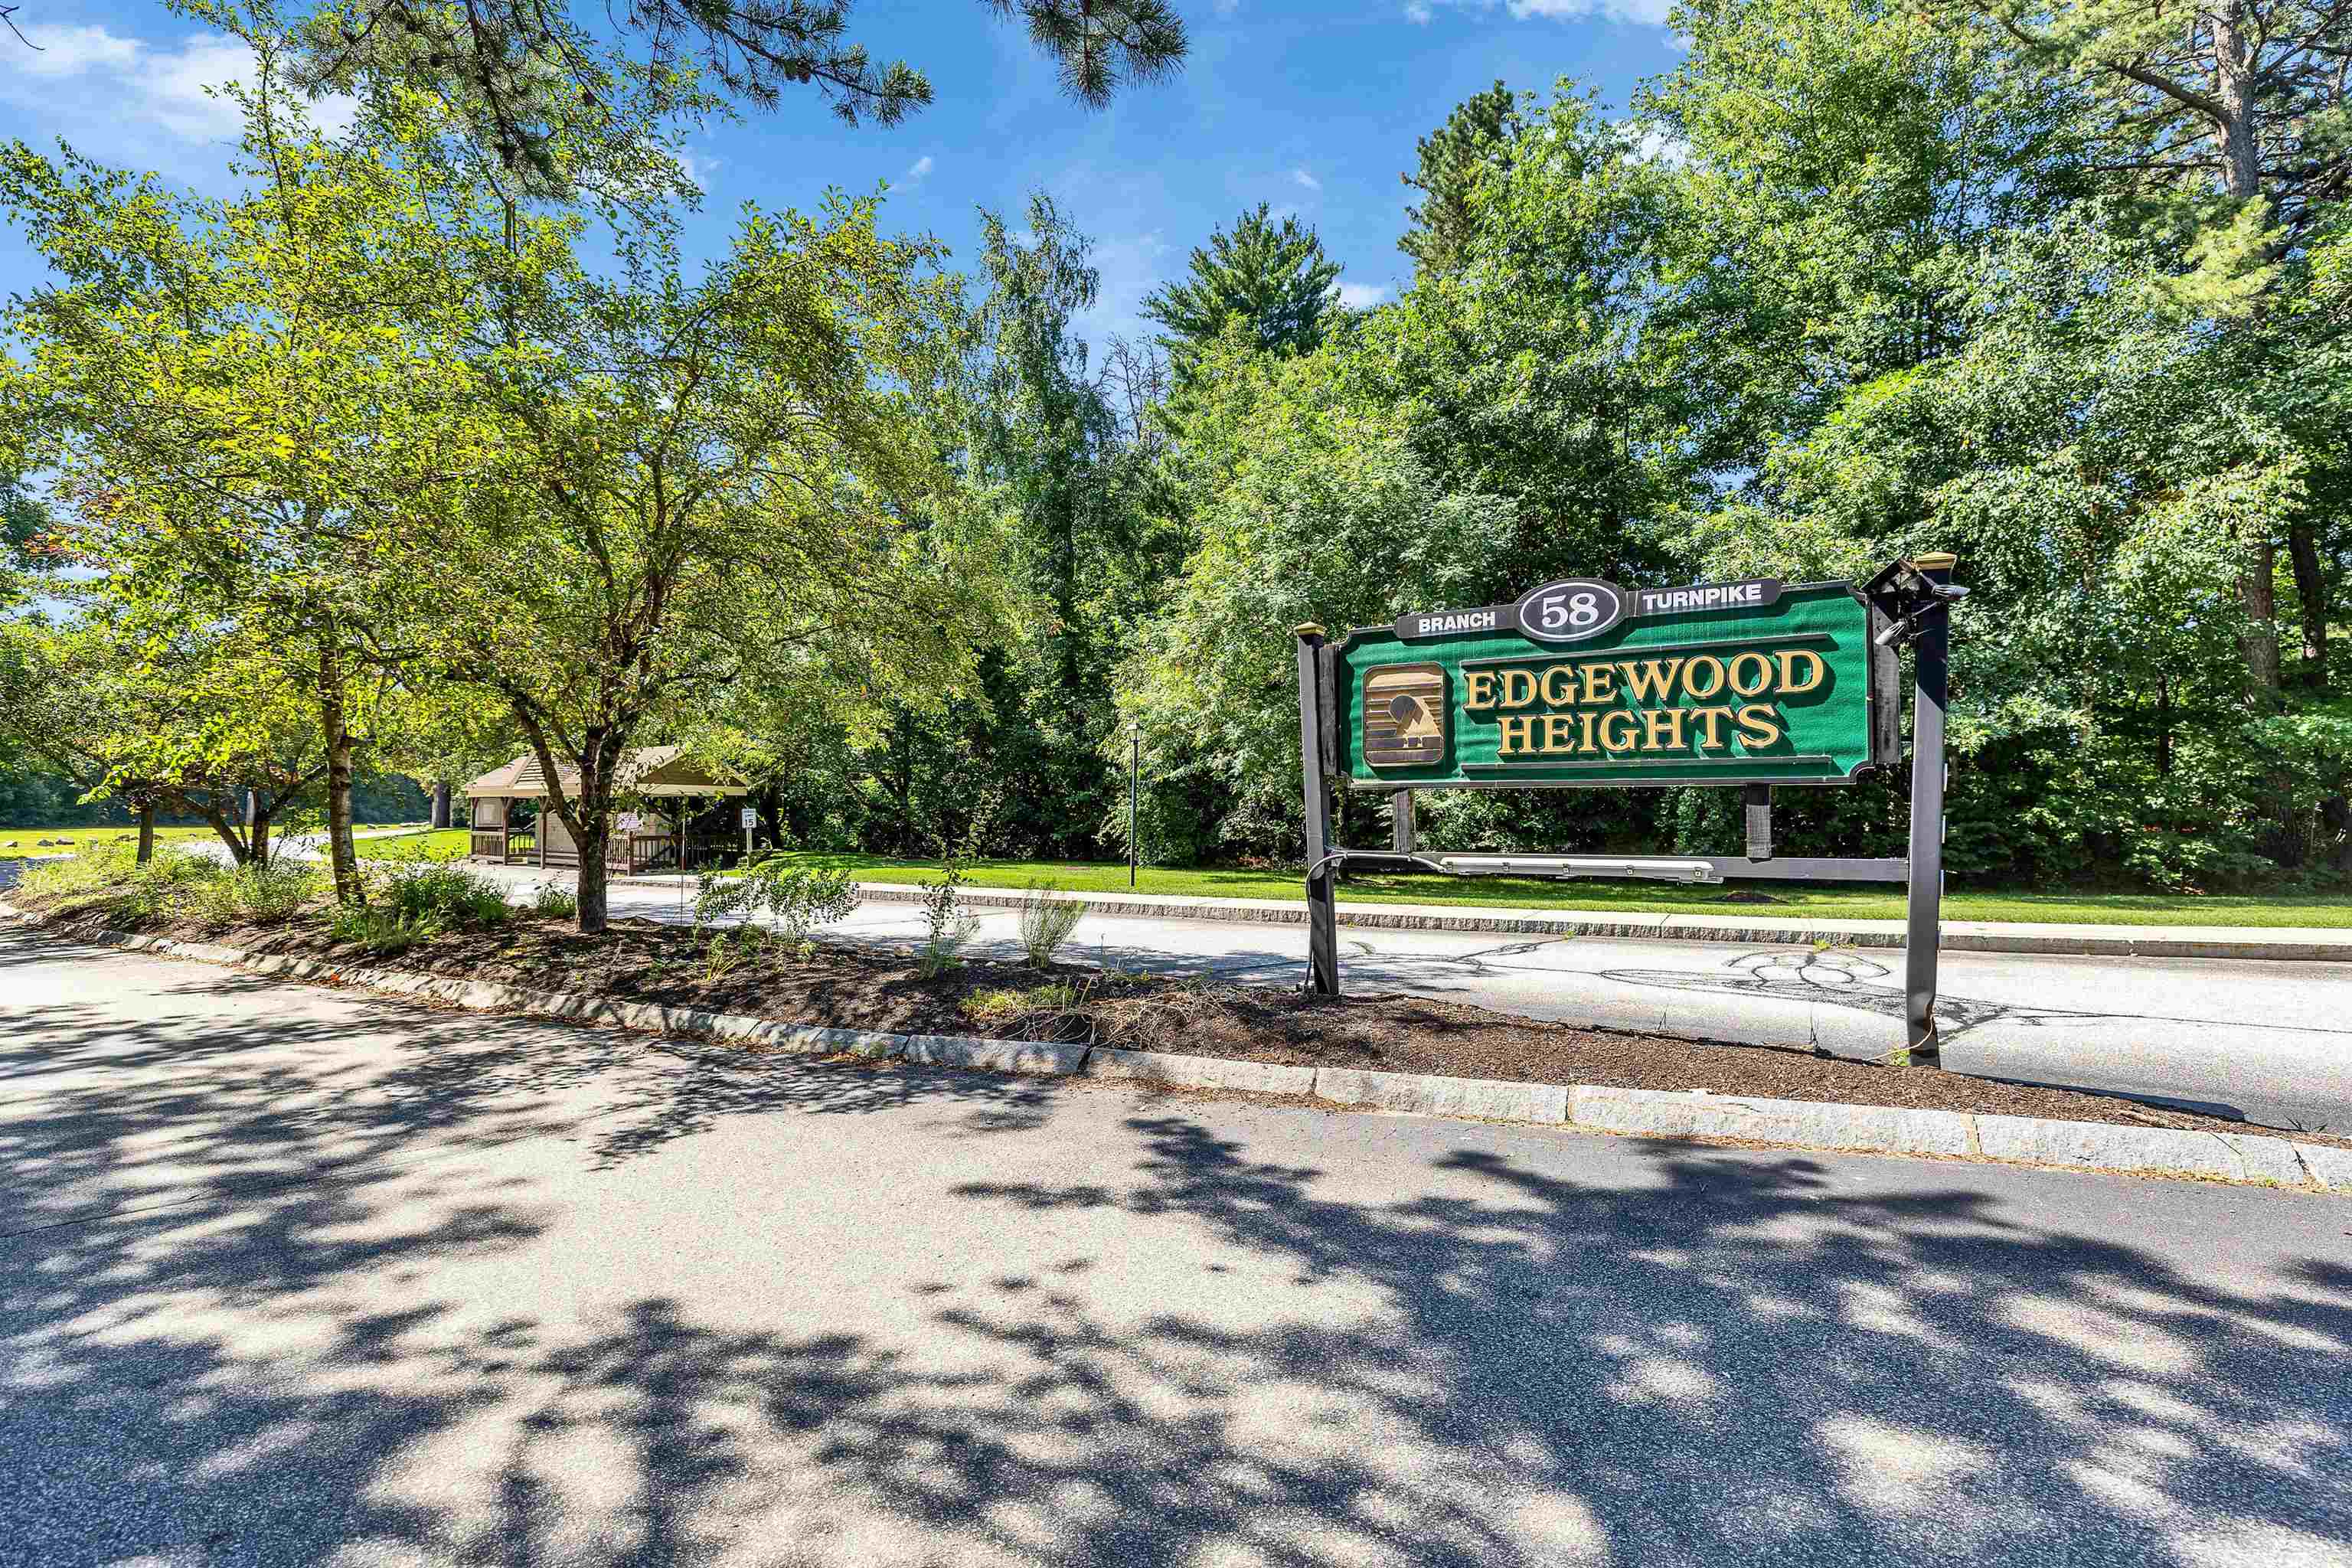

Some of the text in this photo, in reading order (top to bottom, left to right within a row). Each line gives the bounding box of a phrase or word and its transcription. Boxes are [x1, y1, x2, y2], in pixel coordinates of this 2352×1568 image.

[1419, 583, 1762, 633] BRANCH 58 TURNPIKE
[1464, 649, 1825, 710] EDGEWOOD
[1497, 704, 1781, 755] HEIGHTS
